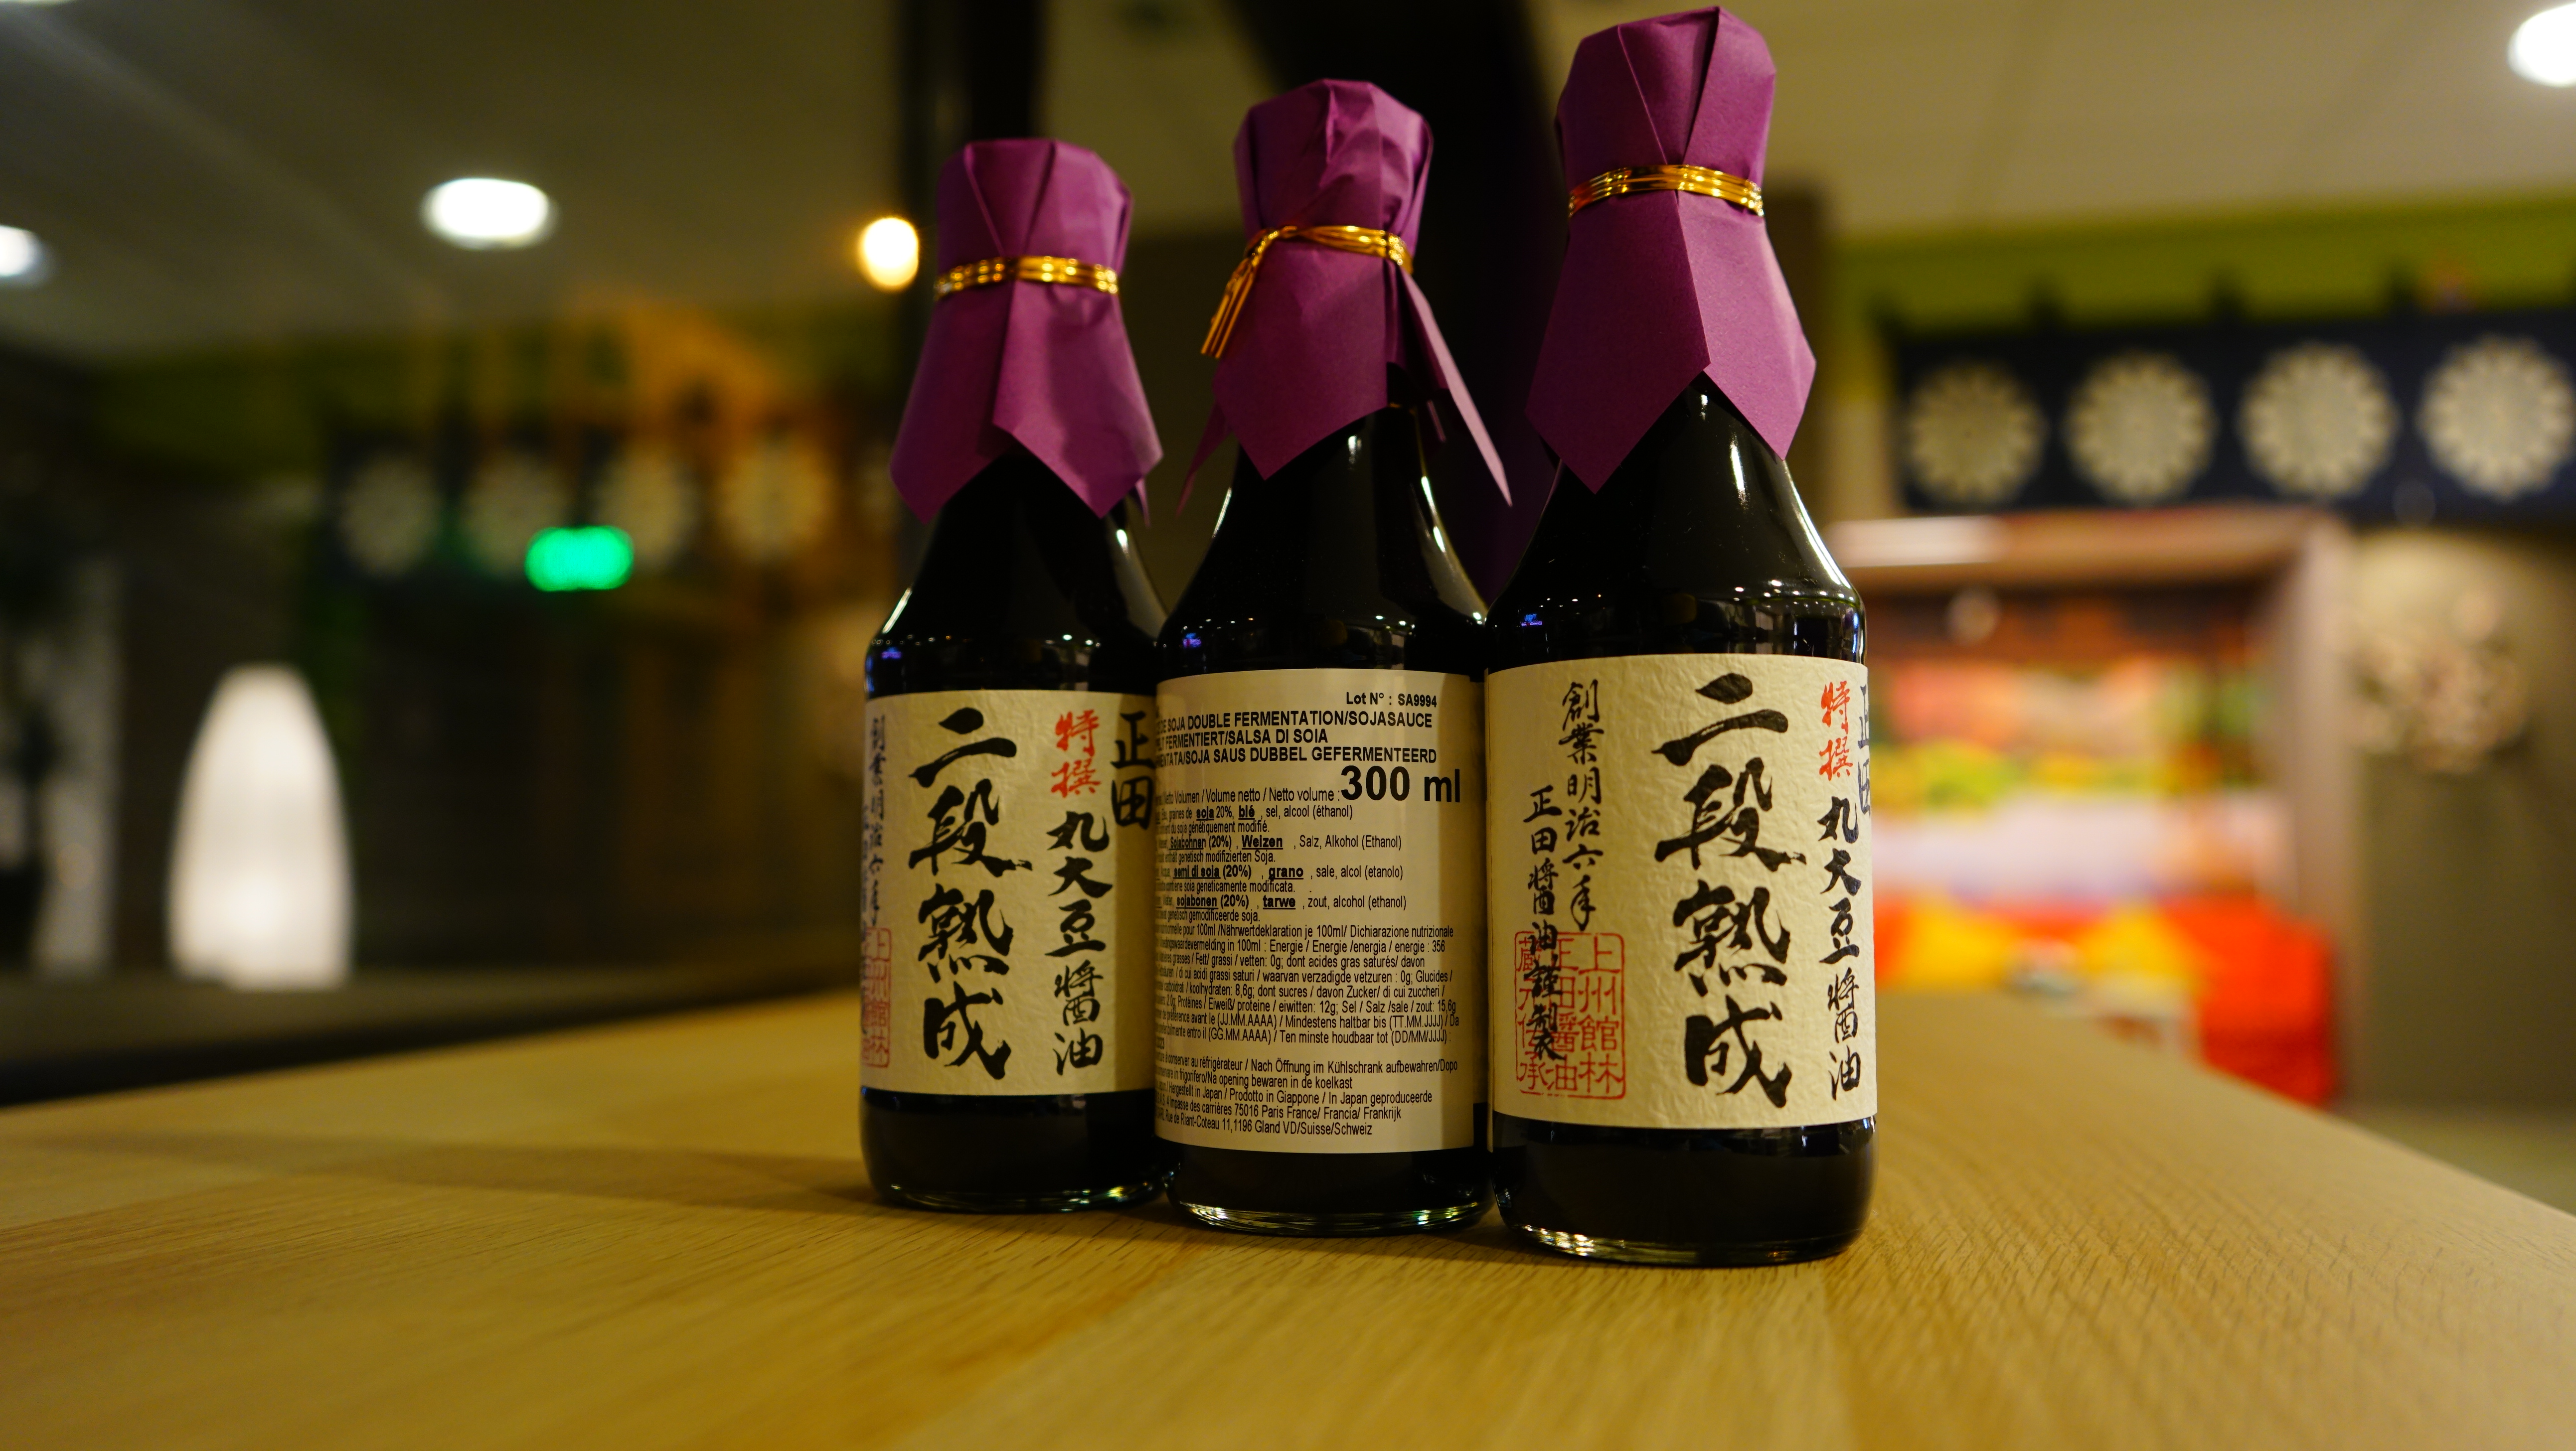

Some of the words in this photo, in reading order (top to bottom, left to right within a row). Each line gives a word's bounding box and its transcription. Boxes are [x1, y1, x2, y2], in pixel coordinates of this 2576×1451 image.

[1346, 692, 1366, 705] Lot
[1370, 693, 1384, 705] N°
[1398, 694, 1437, 708] SA9994
[1167, 717, 1185, 731] SOJA
[1188, 713, 1230, 728] DOUBLE
[1276, 729, 1288, 743] DI
[1293, 728, 1328, 743] SOIA
[1819, 681, 1853, 781] 特撰
[1051, 709, 1101, 798] 特撰
[1213, 748, 1246, 763] SAUS
[1251, 746, 1307, 761] DUBBEL
[1312, 746, 1437, 763] GEFERMENTEERD
[1110, 711, 1156, 830] 正田
[1341, 765, 1410, 801] 300
[1424, 769, 1460, 802] ml
[1174, 789, 1199, 804] Volumen
[1238, 788, 1260, 802] netto
[1269, 787, 1294, 801] Netto
[1297, 787, 1334, 801] volume
[1196, 806, 1214, 820] soja
[1216, 806, 1234, 820] 20%,
[1238, 805, 1255, 820] blé
[1266, 805, 1281, 819] sel,
[1284, 805, 1309, 817] alcool
[1313, 804, 1353, 820] (éthanol)
[1558, 680, 1604, 931] 創業明治六年
[1189, 821, 1235, 836] génétiquement
[1238, 820, 1269, 833] modifié.
[1169, 835, 1206, 850] Sojabohnen
[1209, 835, 1231, 850] (20%)
[1241, 835, 1283, 850] Weizen
[1299, 835, 1322, 849] Salz,
[1325, 835, 1358, 847] Alkohol
[1362, 835, 1401, 850] (Ethanol)
[1178, 850, 1203, 865] genetisch
[1205, 850, 1251, 862] modifizierten
[1255, 850, 1275, 865] Soja.
[1173, 865, 1189, 878] semi
[1201, 865, 1220, 878] soia
[1223, 865, 1252, 880] (20%)
[1269, 867, 1304, 881] grano
[1316, 865, 1337, 879] sale,
[1341, 865, 1361, 877] alcol
[1365, 865, 1403, 880] (etanolo)
[909, 707, 1032, 1079] 二段熟成
[1184, 881, 1194, 891] soia
[1197, 880, 1247, 894] geneticamente
[1250, 880, 1295, 892] modificata.
[1651, 673, 1806, 1108] 二段熟成
[1176, 894, 1218, 909] sojabonen
[1220, 895, 1249, 909] (20%)
[1263, 895, 1296, 909] tarwe
[1308, 896, 1329, 910] zout,
[1333, 896, 1365, 908] alcohol
[1368, 896, 1406, 910] (ethanol)
[1189, 909, 1239, 923] gemodificeerde
[1242, 909, 1260, 924] soja.
[1196, 924, 1215, 936] 100ml
[1350, 925, 1409, 937] Dichiarazione
[1412, 925, 1453, 937] nutrizionale
[1237, 939, 1261, 952] 100ml
[1270, 939, 1303, 955] Energie
[1312, 940, 1347, 955] Energie
[1396, 941, 1425, 955] energie
[1433, 940, 1445, 952] 356
[1172, 953, 1190, 966] grasses
[1212, 954, 1232, 968] grassi
[1240, 955, 1267, 967] vetten:
[1287, 955, 1305, 967] dont
[1309, 956, 1337, 967] acides
[1341, 957, 1360, 970] gras
[1401, 956, 1425, 967] davon
[1193, 968, 1207, 980] acidi
[1210, 968, 1230, 983] grassi
[1233, 969, 1254, 981] saturi
[1263, 973, 1299, 982] waarvan
[1302, 970, 1351, 986] verzadigde
[1354, 971, 1392, 983] vetzuren
[1416, 970, 1448, 983] Glucides
[1189, 982, 1232, 997] koolhydraten:
[1235, 984, 1254, 999] 8,6g;
[1258, 984, 1276, 997] dont
[1279, 987, 1307, 997] sucres
[1317, 986, 1343, 998] davon
[1408, 985, 1440, 997] zuccheri
[1178, 996, 1202, 1009] Protéines
[1237, 1000, 1270, 1014] proteine
[1279, 1000, 1315, 1013] eiwitten:
[1320, 1001, 1338, 1016] 12g;
[1342, 1001, 1356, 1013] Sel
[1366, 1001, 1385, 1013] Salz
[1416, 1001, 1434, 1013] zout:
[1438, 1000, 1455, 1014] 15,6g
[1577, 935, 1623, 1094] 上州館林
[1191, 1013, 1207, 1023] avant
[1217, 1013, 1277, 1029] (JJ.MM.AAAA)
[1286, 1015, 1336, 1028] Mindestens
[1340, 1016, 1370, 1028] haltbar
[1390, 1015, 1443, 1030] (TT.MM.JJJJ)
[1208, 1027, 1271, 1045] (GG.MM.AAAA)
[1299, 1030, 1329, 1043] minste
[1332, 1031, 1374, 1043] houdbaar
[1200, 1056, 1243, 1071] réfrigérateur
[1251, 1059, 1272, 1072] Nach
[1276, 1058, 1310, 1075] Öffnung
[1328, 1061, 1383, 1073] Kühlschrank
[1219, 1073, 1248, 1089] opening
[1252, 1074, 1287, 1087] bewaren
[1316, 1076, 1352, 1088] koelkast
[1169, 1082, 1193, 1097] Hergestellt
[1203, 1086, 1222, 1100] Japan
[1230, 1088, 1263, 1102] Prodotto
[1277, 1090, 1319, 1106] Giappone
[1340, 1092, 1367, 1106] Japan
[1371, 1090, 1432, 1106] geproduceerde
[1171, 1096, 1188, 1111] Impasse
[1202, 1102, 1232, 1115] carrières
[1235, 1103, 1258, 1117] 75016
[1262, 1105, 1283, 1118] Paris
[1364, 1107, 1401, 1122] Frankrijk
[1181, 1113, 1219, 1130] Riant-Coteau
[1222, 1118, 1252, 1133] 11,1196
[1255, 1119, 1280, 1133] Gland
